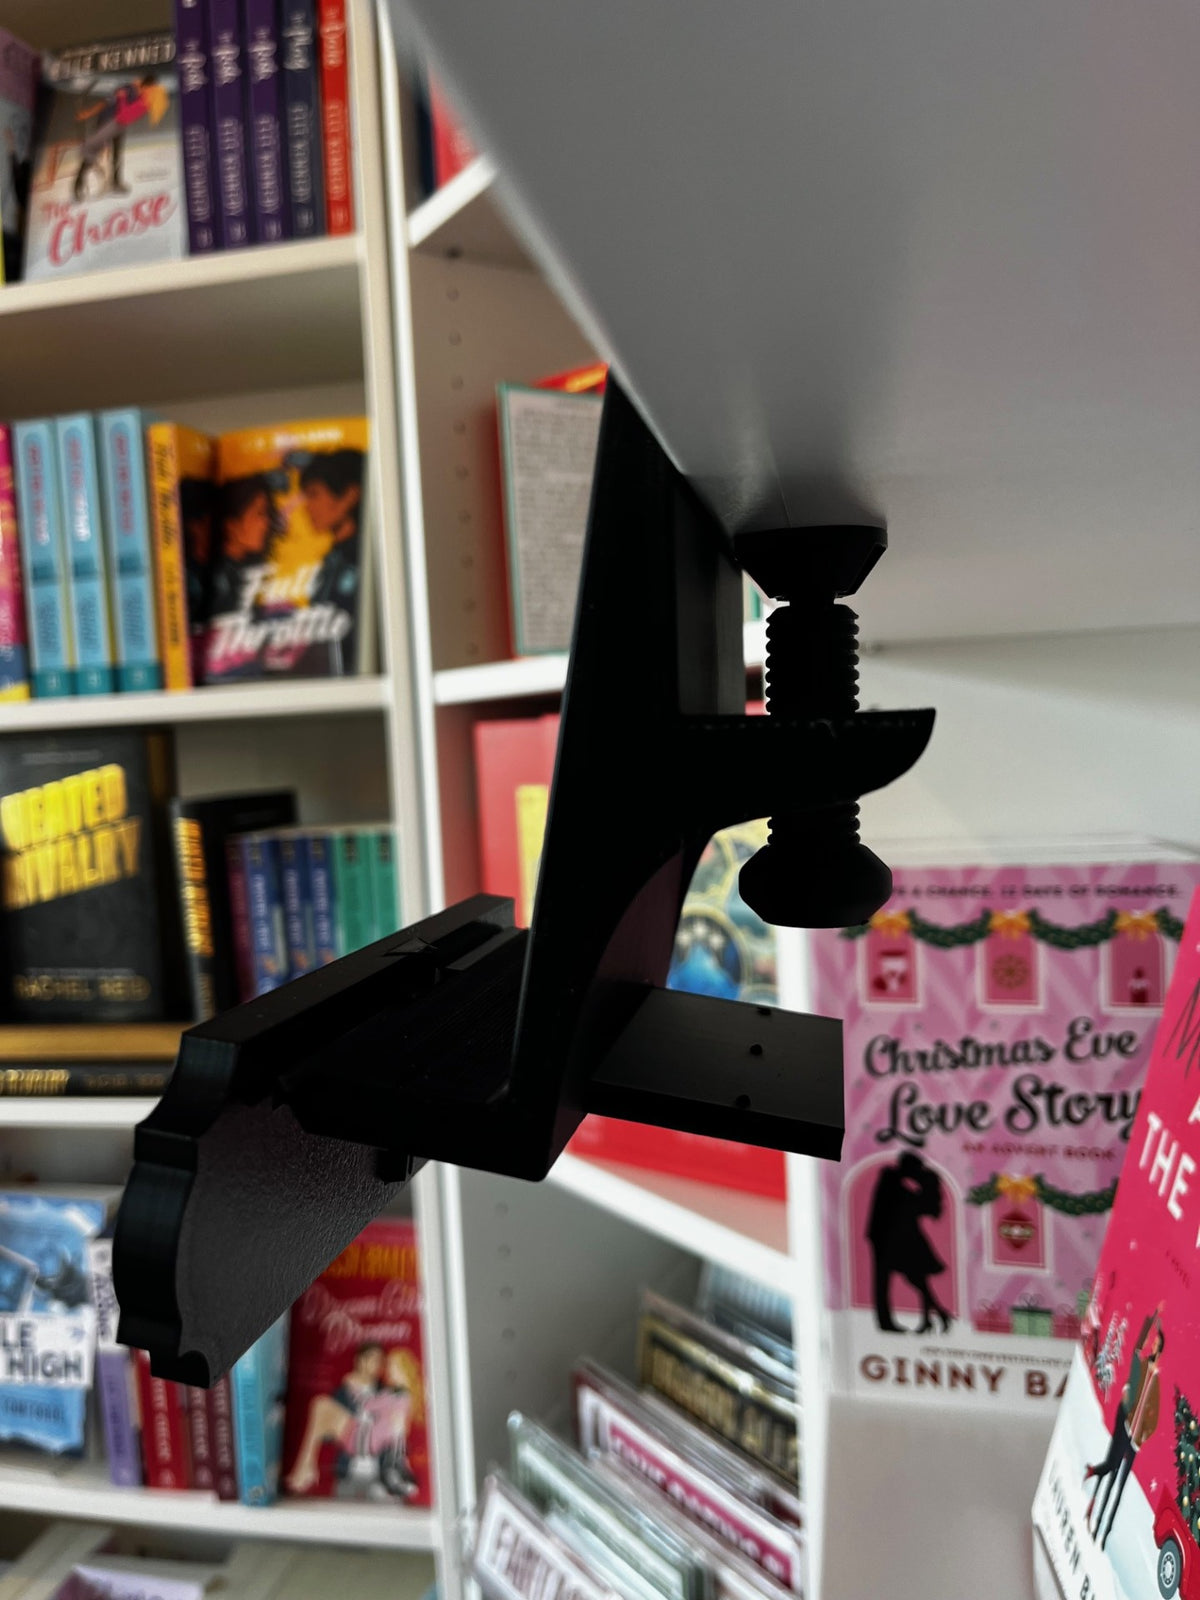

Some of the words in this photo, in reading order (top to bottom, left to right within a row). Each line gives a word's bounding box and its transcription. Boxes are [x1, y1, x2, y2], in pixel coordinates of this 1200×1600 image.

[48, 191, 177, 267] Chase
[209, 603, 351, 664] Throttle
[864, 1034, 1054, 1078] Christmas
[1064, 1016, 1138, 1064] Eve
[875, 1081, 991, 1148] Love
[1004, 1073, 1142, 1142] Story
[1139, 1110, 1197, 1221] THE
[0, 1319, 36, 1348] LE
[8, 1345, 83, 1379] HIGH
[860, 1353, 1004, 1393] GINNY
